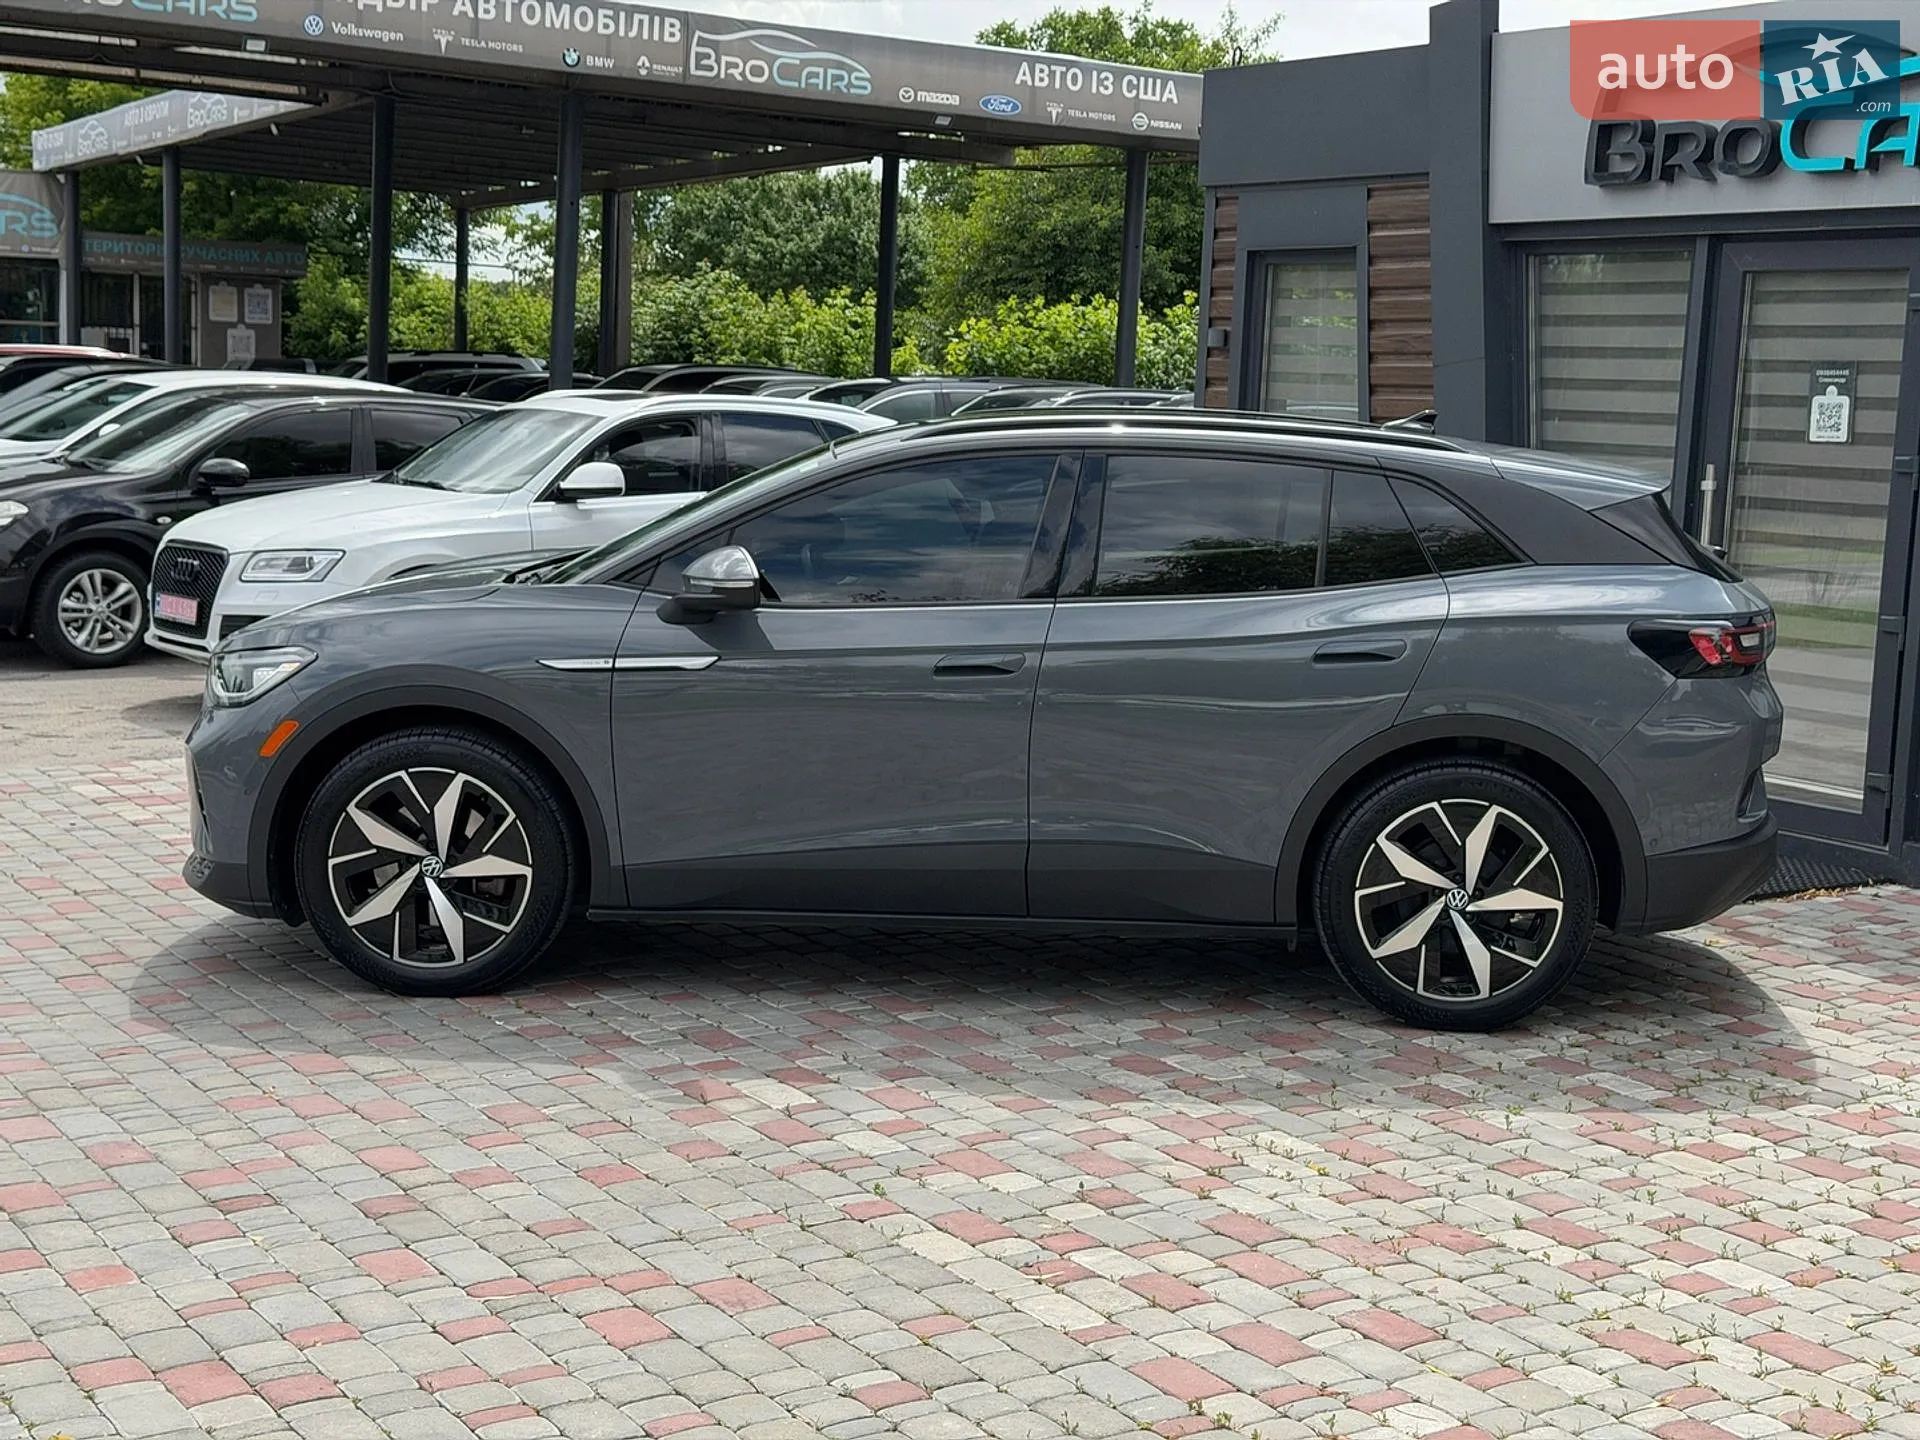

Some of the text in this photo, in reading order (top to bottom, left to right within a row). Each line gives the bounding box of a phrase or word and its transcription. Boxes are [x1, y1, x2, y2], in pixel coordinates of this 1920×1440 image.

[452, 0, 682, 43] АВТОМОБІЛІВ
[331, 21, 404, 42] Volkswagen
[461, 37, 523, 53] TESLA MOTORS
[586, 55, 615, 70] BMW
[652, 63, 683, 73] RENAULT
[1015, 61, 1179, 104] АВТО ІЗ США
[987, 98, 1013, 112] Ford
[1067, 109, 1116, 122] TESLA MOTORS
[1150, 120, 1182, 131] NISSAN
[84, 238, 165, 257] ТЕРИТОРІ
